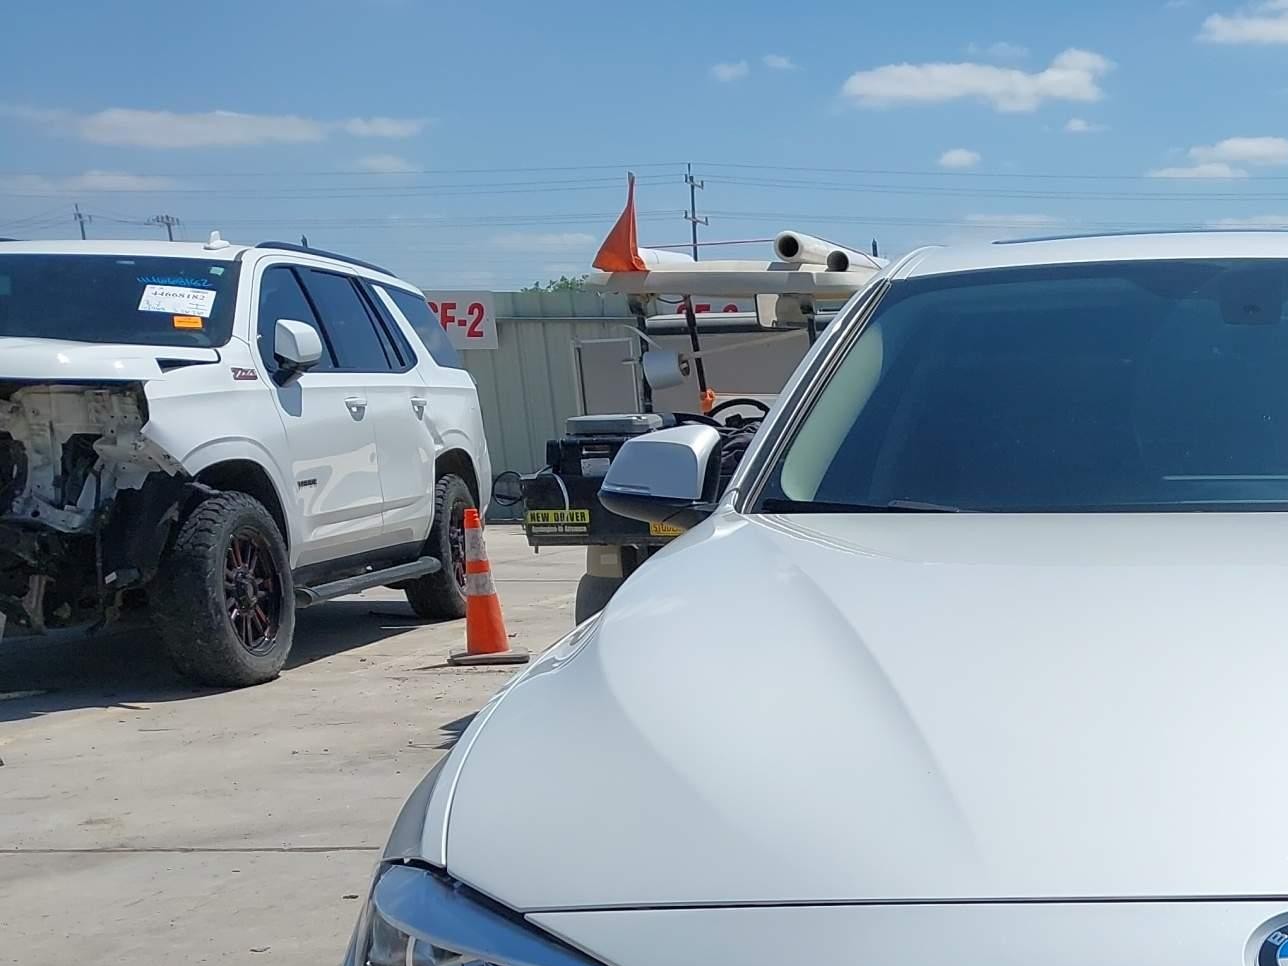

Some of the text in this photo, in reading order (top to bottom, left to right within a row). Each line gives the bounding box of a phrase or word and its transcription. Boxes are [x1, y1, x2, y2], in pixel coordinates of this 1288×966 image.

[427, 302, 485, 338] F-2
[530, 511, 586, 522] NEW DRIVER
